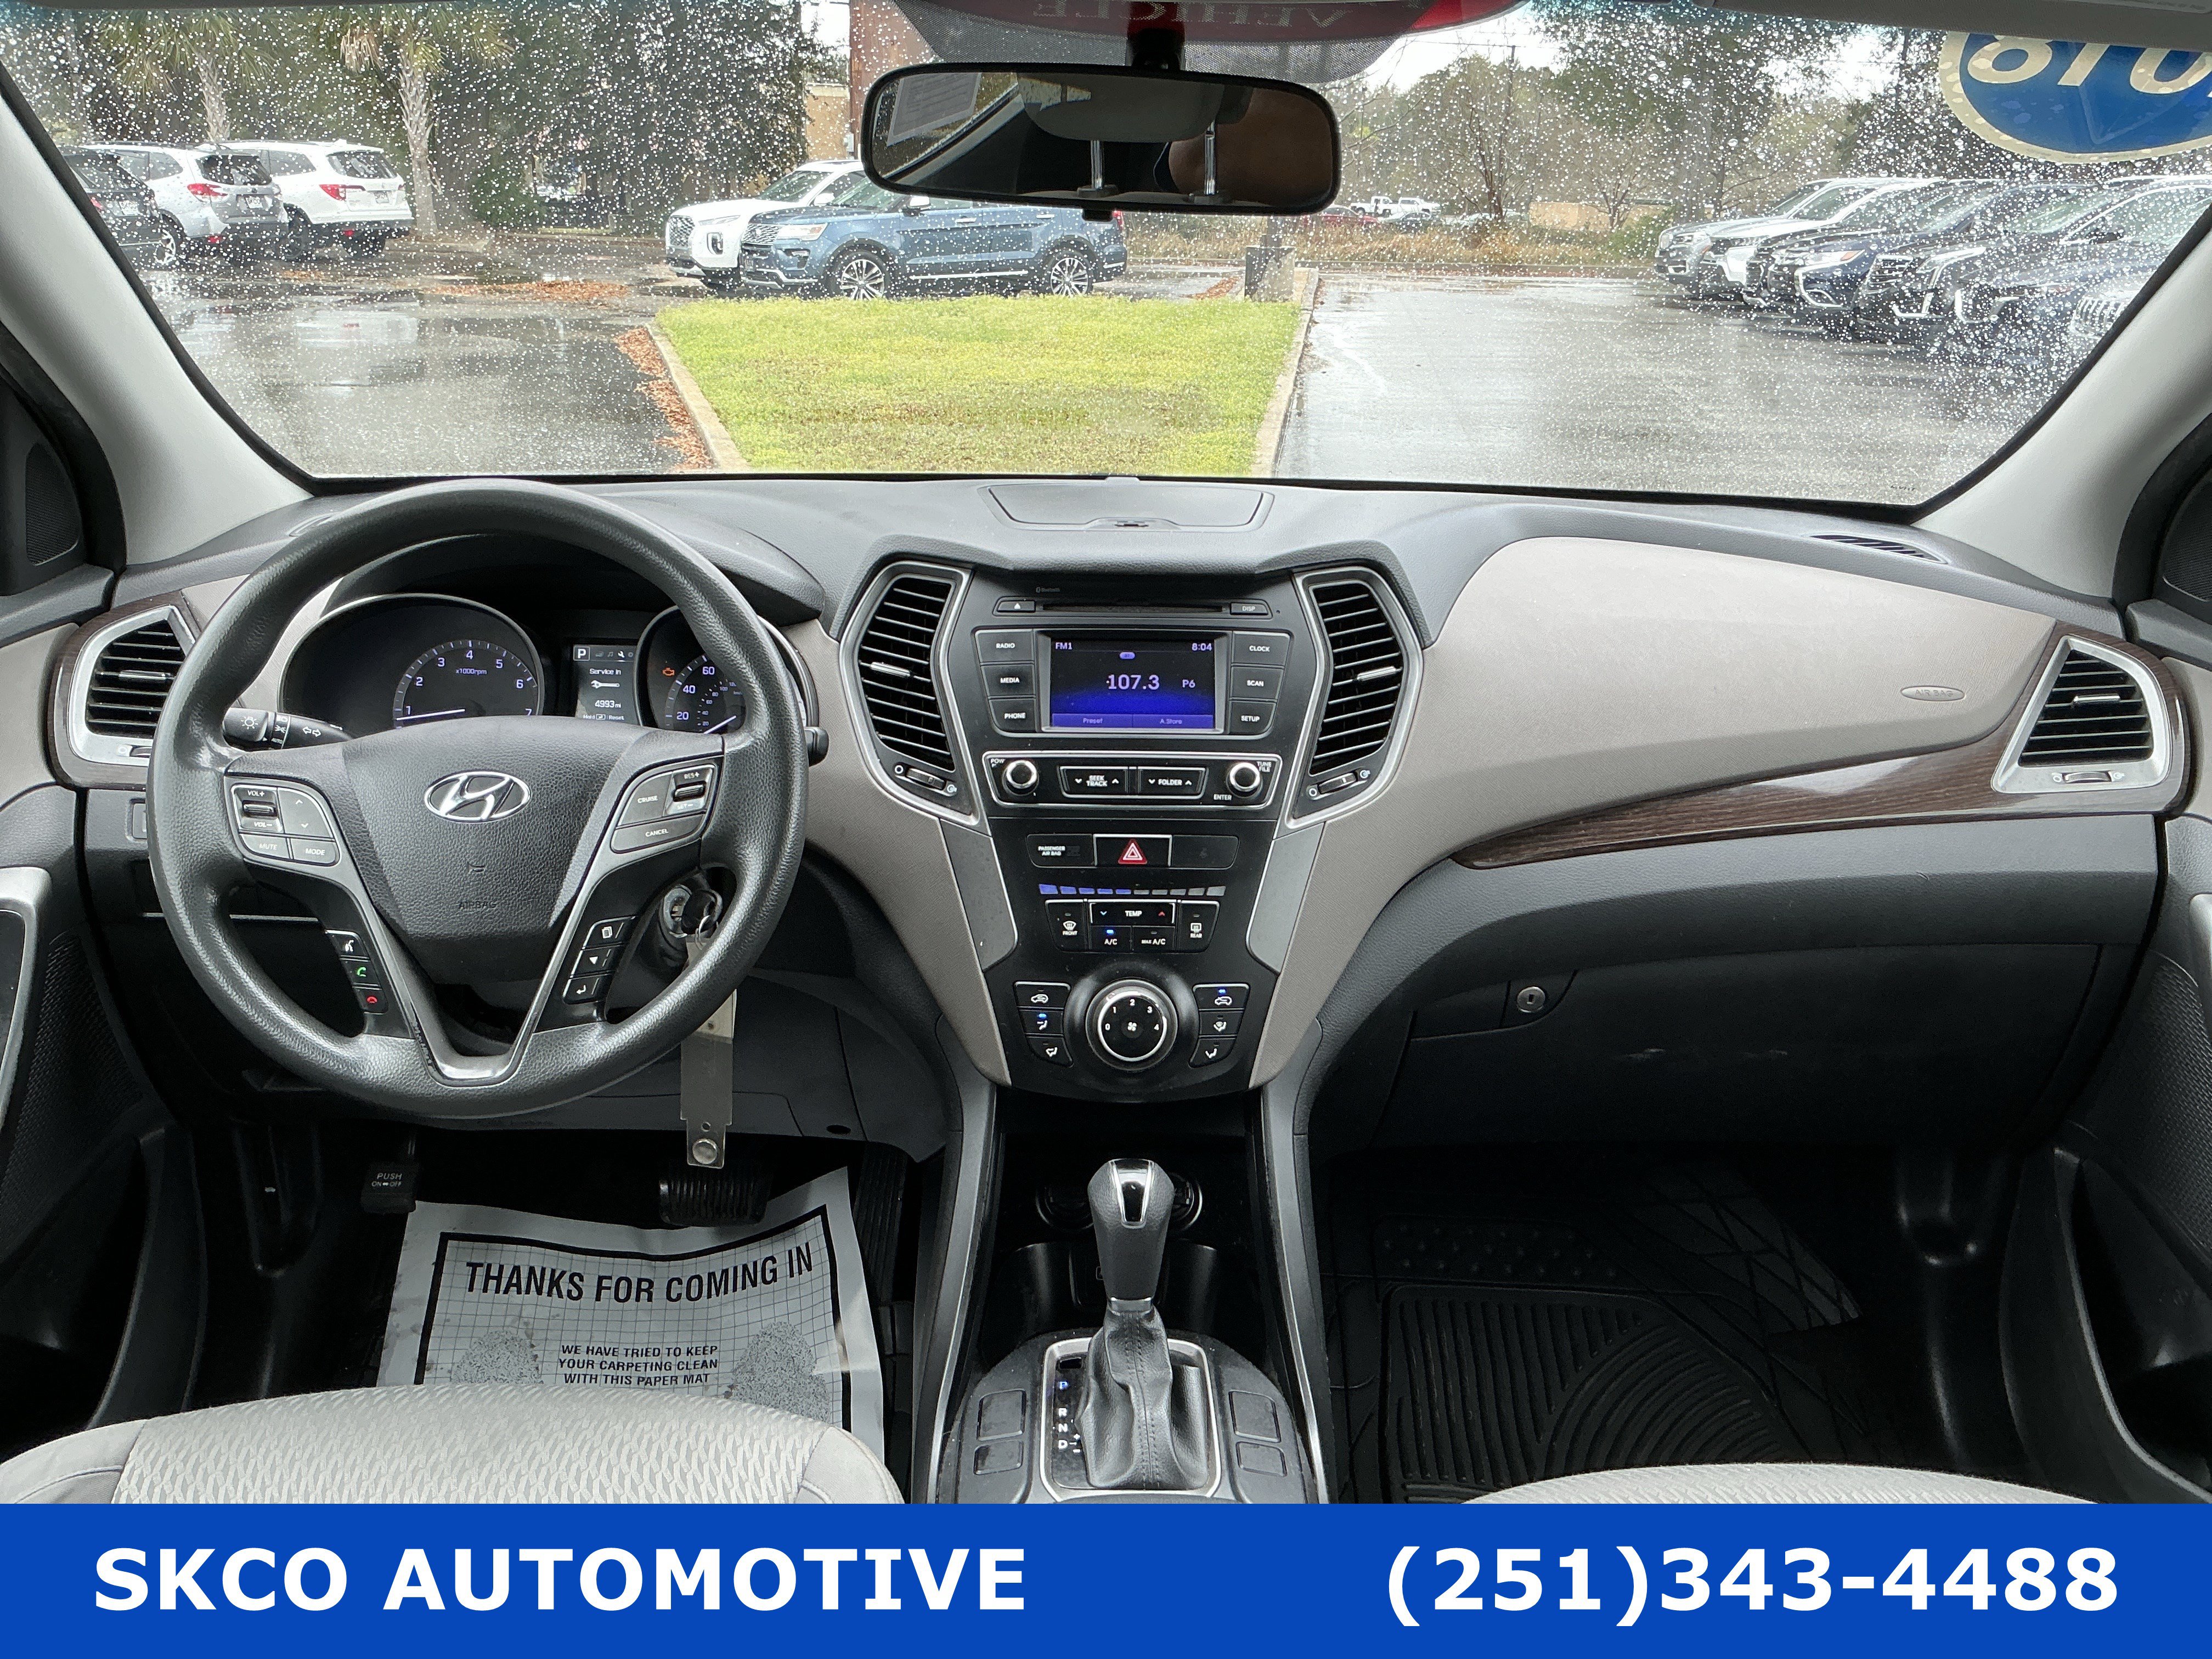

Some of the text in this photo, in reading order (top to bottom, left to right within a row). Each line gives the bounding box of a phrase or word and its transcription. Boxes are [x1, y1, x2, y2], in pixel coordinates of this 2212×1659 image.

[1192, 642, 1212, 651] 8:04
[466, 650, 473, 659] 4
[578, 648, 586, 659] P
[437, 657, 445, 667] 3
[495, 659, 503, 669] 5
[702, 666, 715, 675] 60
[415, 677, 424, 686] 2
[516, 679, 524, 689] 6
[1108, 674, 1160, 690] 107.3
[1182, 679, 1195, 688] P6
[682, 685, 696, 694] 40
[406, 706, 411, 715] 1
[676, 712, 689, 720] 20
[645, 828, 669, 837] CANCEL
[466, 1242, 812, 1303] THANKS FOR COMING IN
[561, 1345, 718, 1358] WE HAVE TRIED TO KEEP
[559, 1358, 718, 1372] YOUR CARPETING CLEAN
[564, 1373, 710, 1386] WITH THIS PAPER MAT
[1059, 1381, 1068, 1389] P
[1058, 1408, 1067, 1417] R
[1058, 1423, 1068, 1432] N
[1058, 1440, 1068, 1449] D
